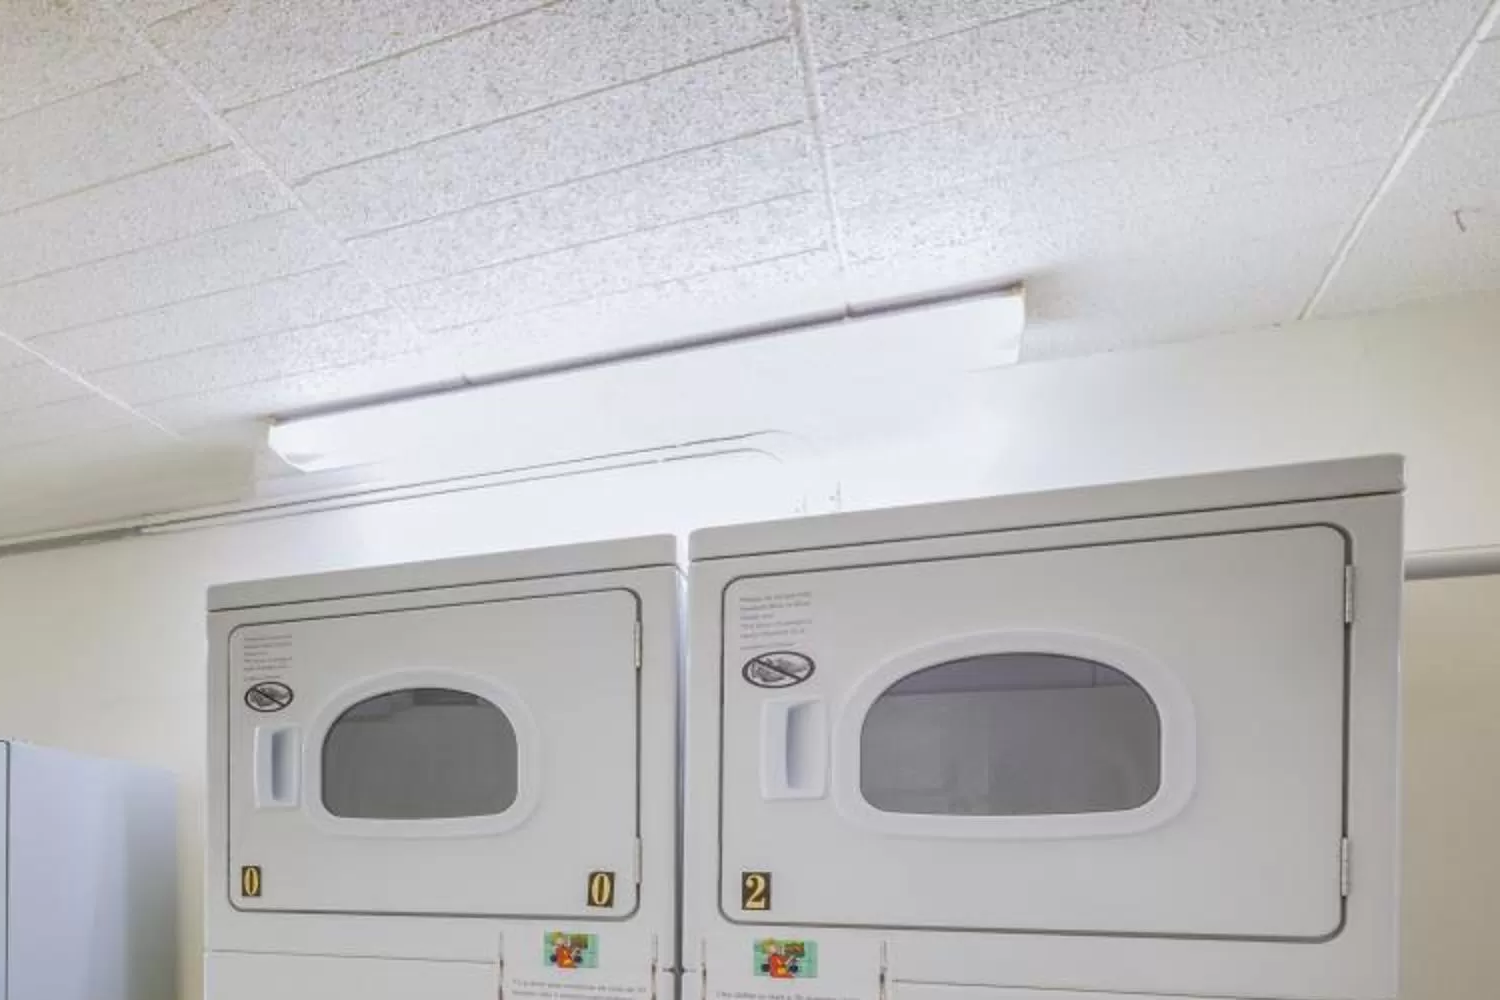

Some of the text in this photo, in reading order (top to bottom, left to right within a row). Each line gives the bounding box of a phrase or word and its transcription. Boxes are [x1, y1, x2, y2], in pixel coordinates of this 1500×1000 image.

[243, 866, 259, 897] 0
[591, 872, 611, 905] 0
[744, 873, 766, 909] 2
